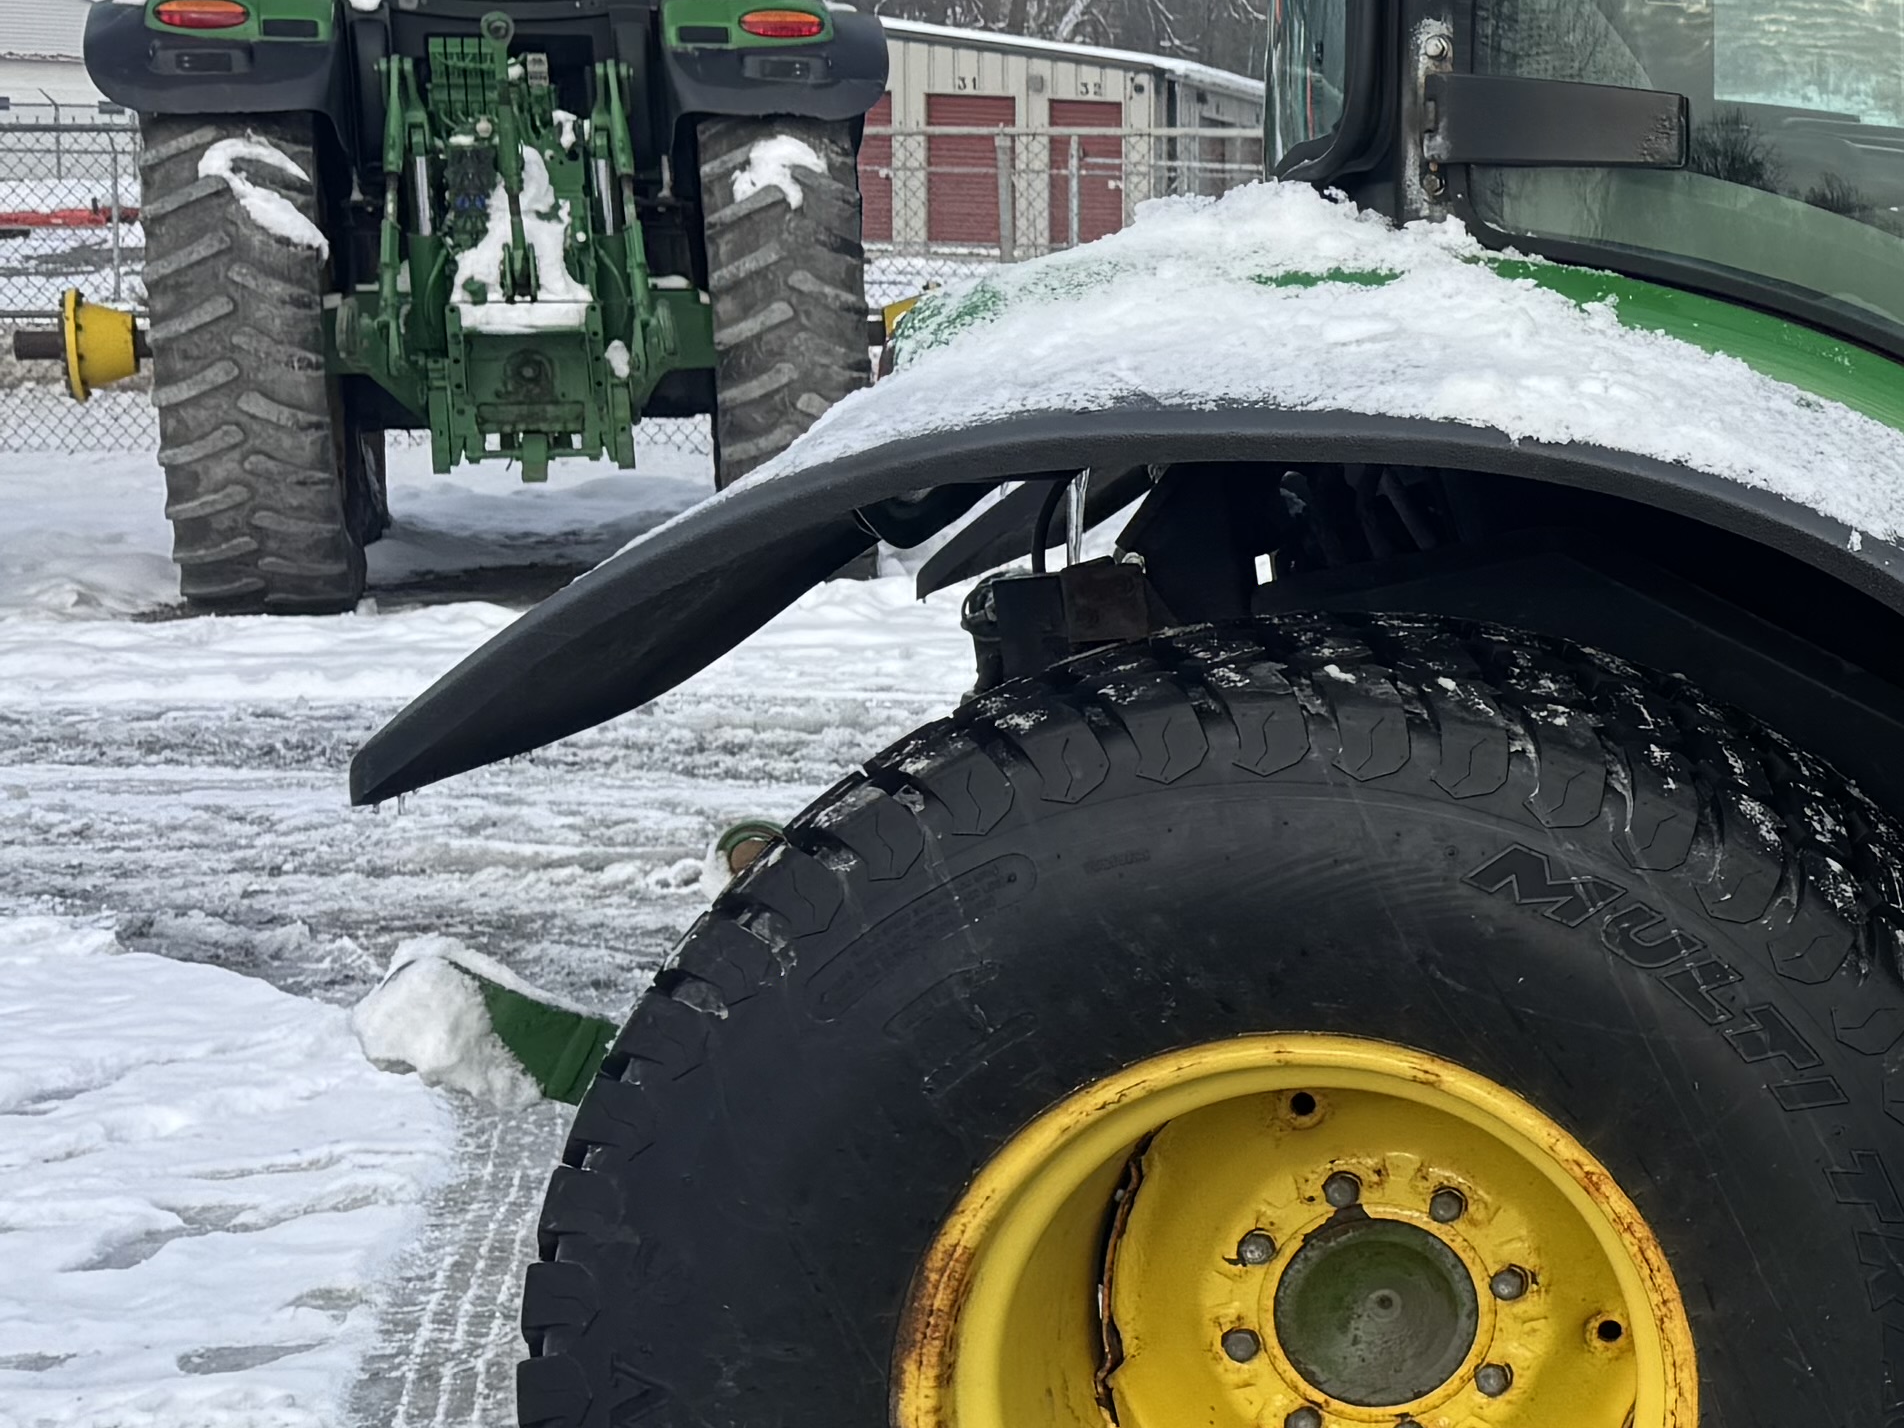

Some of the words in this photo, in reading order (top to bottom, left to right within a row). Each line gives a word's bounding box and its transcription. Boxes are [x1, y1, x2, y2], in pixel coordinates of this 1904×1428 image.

[957, 75, 978, 91] 31
[1079, 81, 1103, 96] 32
[1461, 842, 1850, 1113] MULTI
